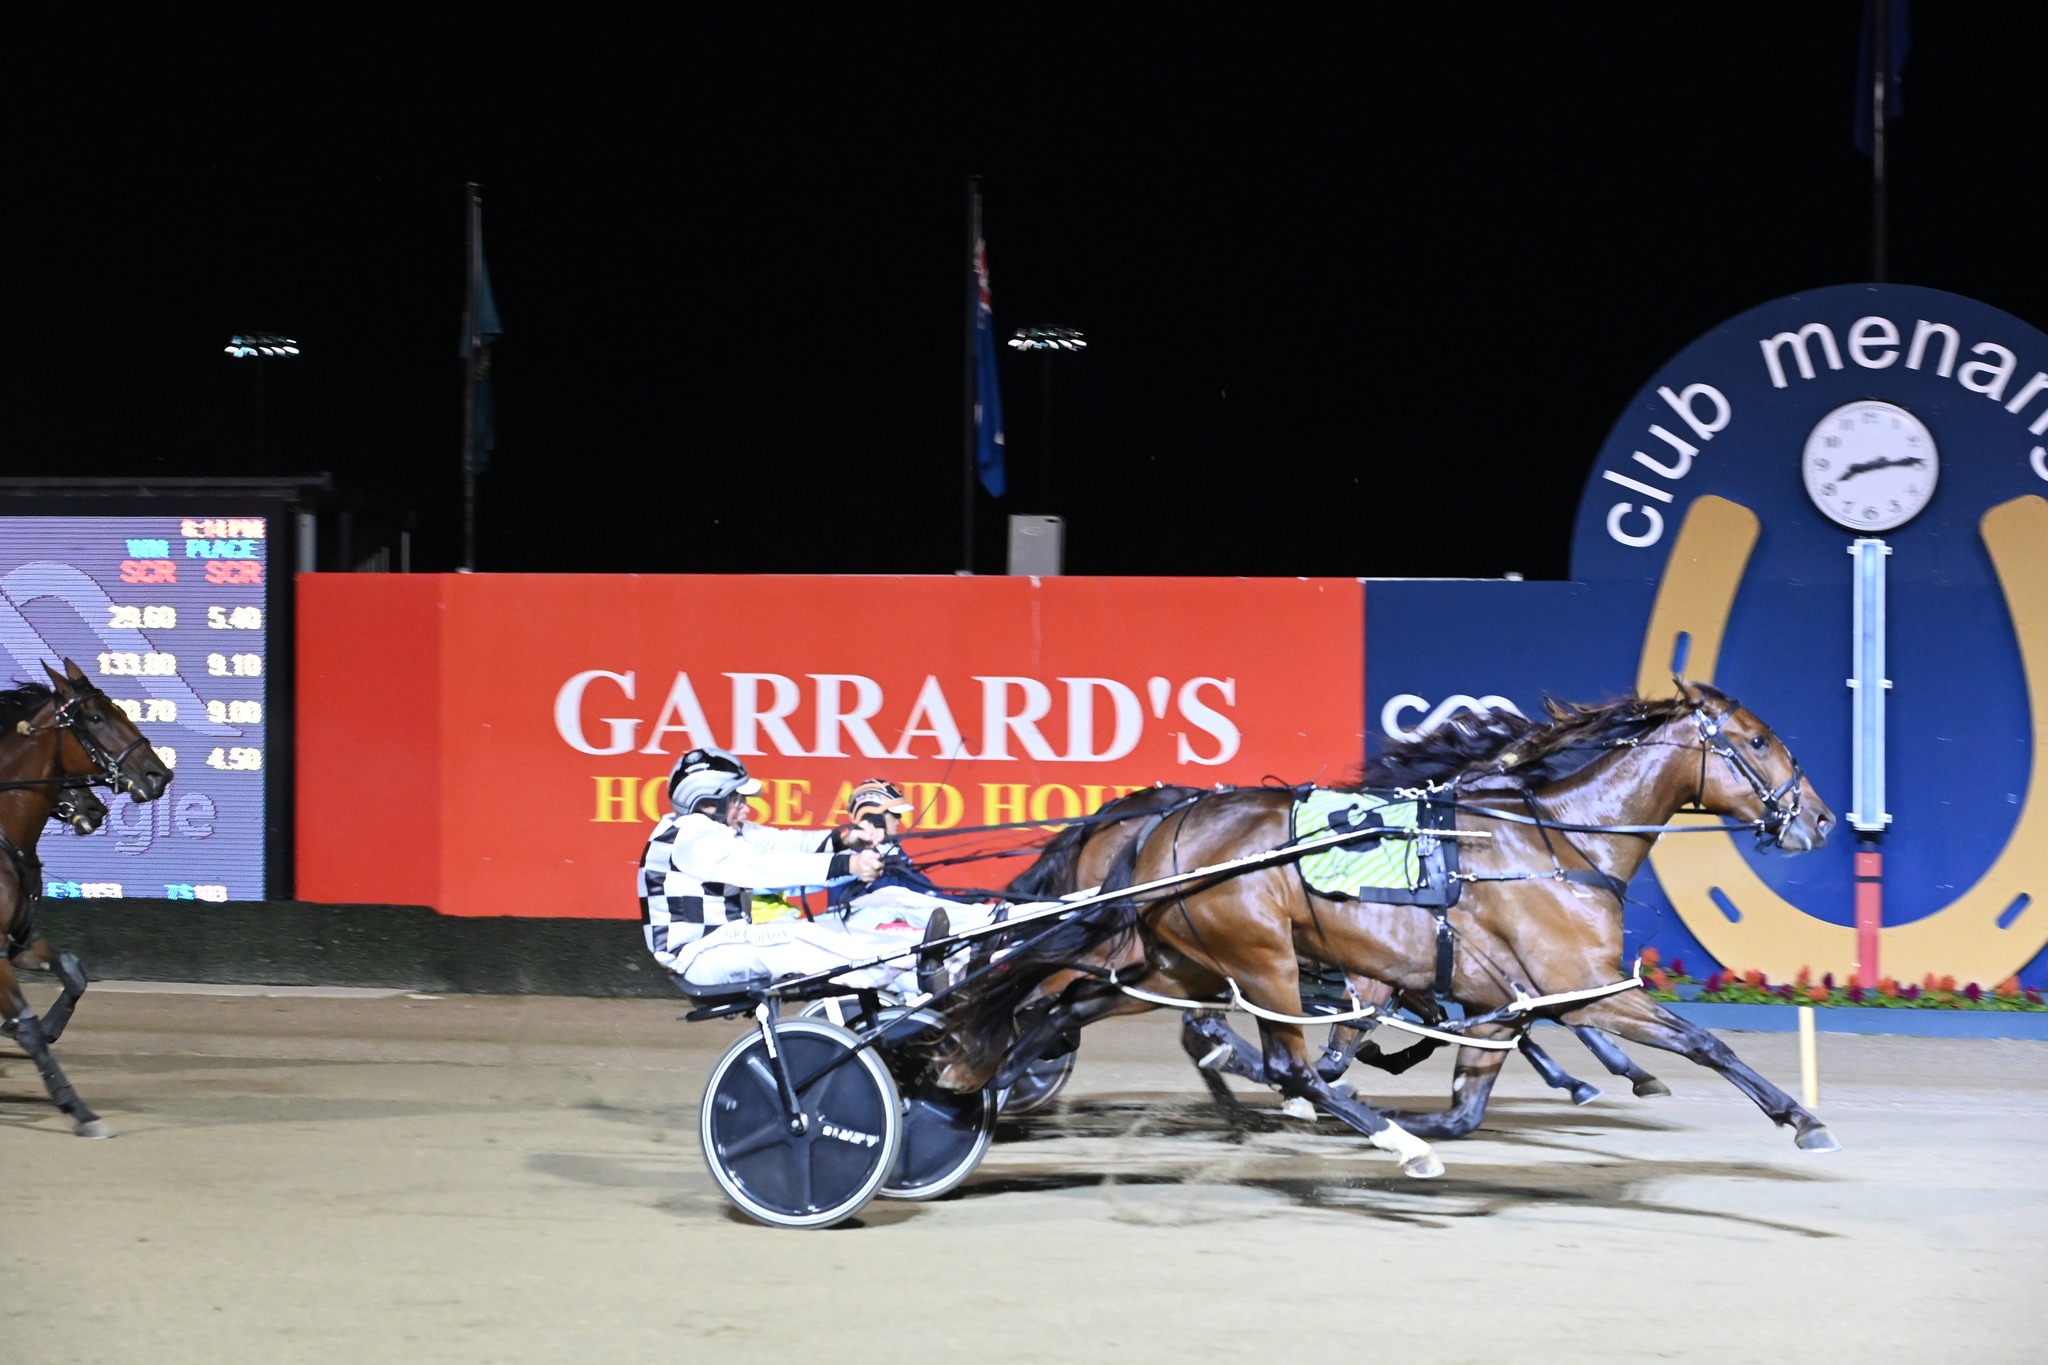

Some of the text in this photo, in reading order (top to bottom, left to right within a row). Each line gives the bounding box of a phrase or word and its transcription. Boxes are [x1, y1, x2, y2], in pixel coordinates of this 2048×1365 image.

[1603, 383, 1732, 548] club
[185, 539, 260, 558] PLACE
[119, 560, 263, 584] SCR SCR
[207, 606, 262, 630] 5.40
[553, 669, 1241, 766] GARRARD'S
[206, 747, 262, 770] 4.50
